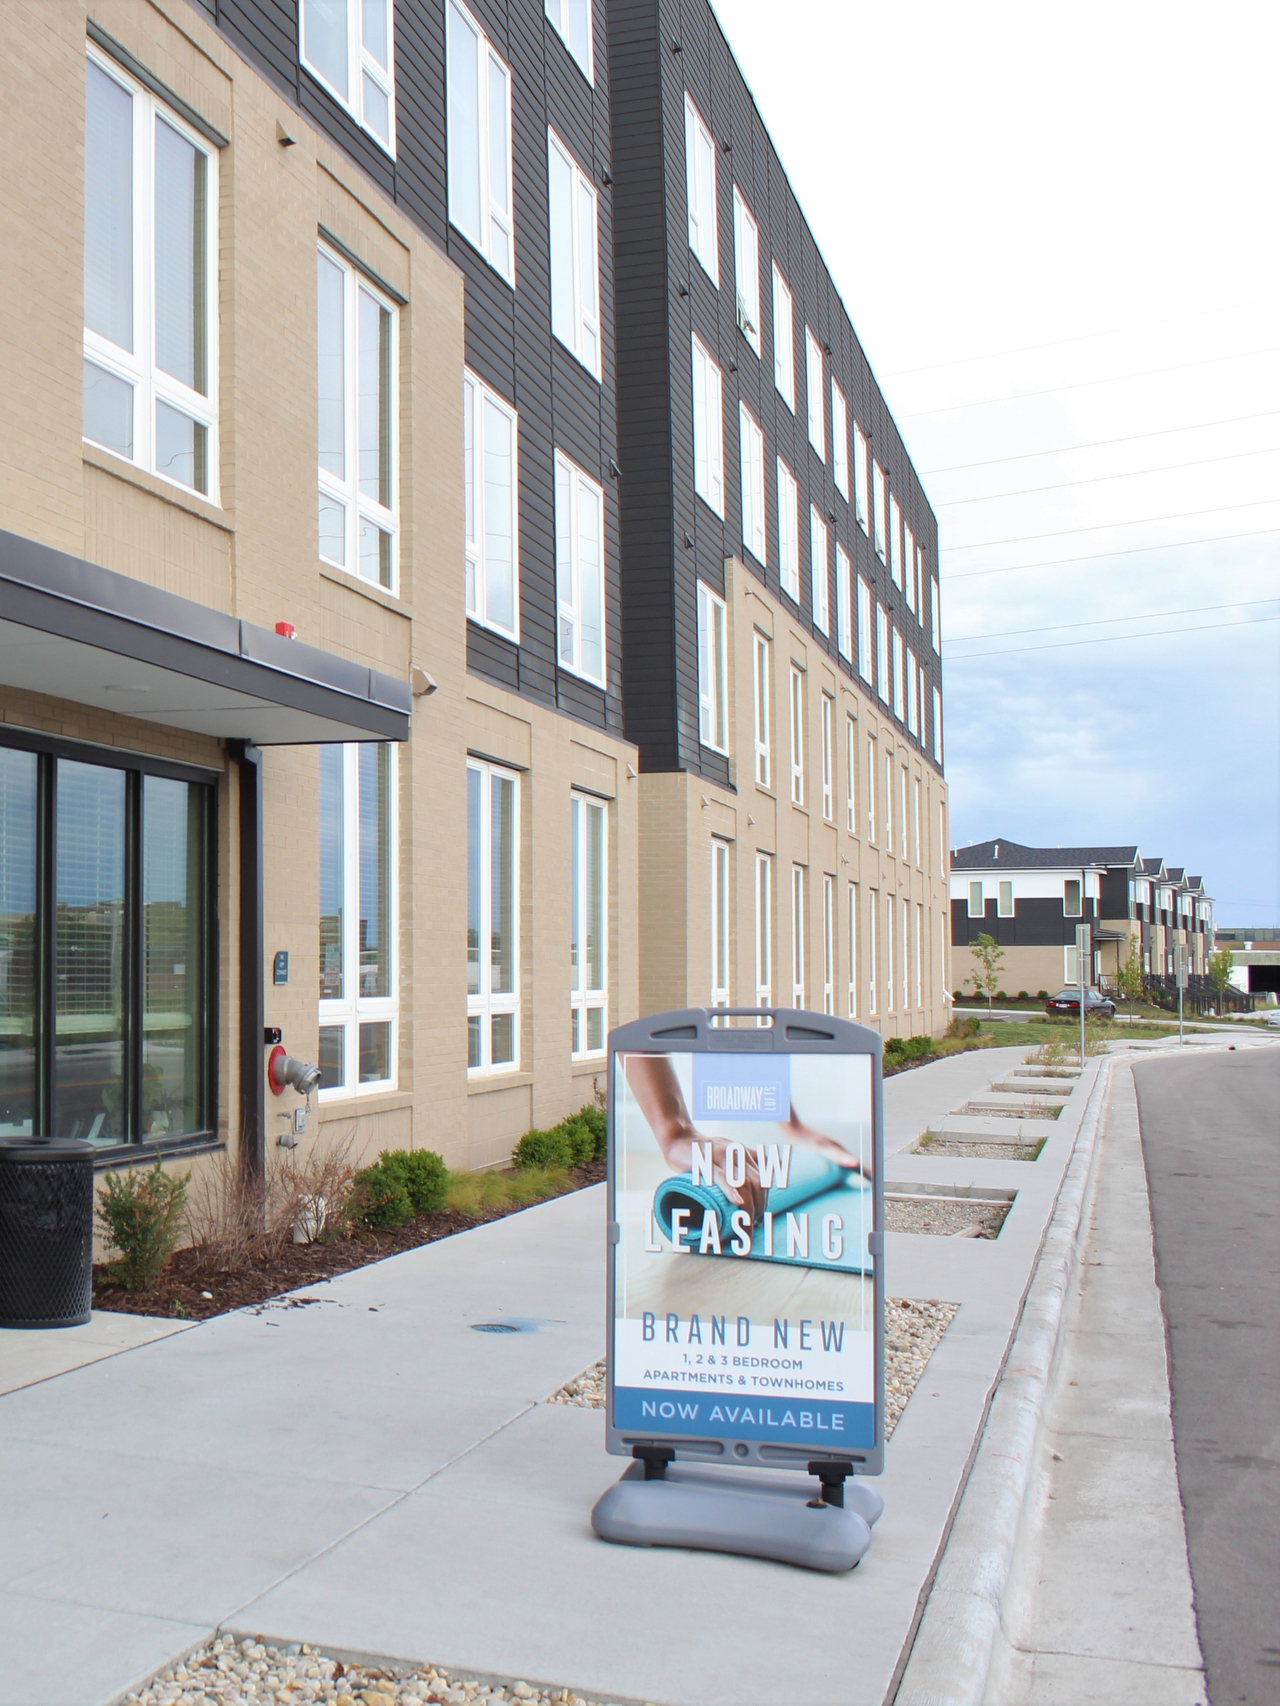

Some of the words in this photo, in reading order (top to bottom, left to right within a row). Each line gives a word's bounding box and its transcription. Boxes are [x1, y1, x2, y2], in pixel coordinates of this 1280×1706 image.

[707, 1085, 763, 1110] BROADWAY
[763, 1085, 777, 1111] LOFTS
[691, 1141, 792, 1189] NOW
[644, 1207, 844, 1260] LEASING
[642, 1311, 750, 1347] BRAND
[773, 1317, 845, 1353] NEW
[682, 1353, 692, 1366] 1,
[695, 1354, 704, 1365] 2
[707, 1355, 716, 1366] &
[720, 1355, 728, 1366] 3
[732, 1356, 803, 1371] BEDROOM
[643, 1369, 734, 1385] APARTMENTS
[737, 1375, 747, 1386] &
[750, 1376, 844, 1392] TOWNHOMES
[641, 1400, 700, 1420] NOW
[708, 1405, 845, 1431] AVAILABLE
